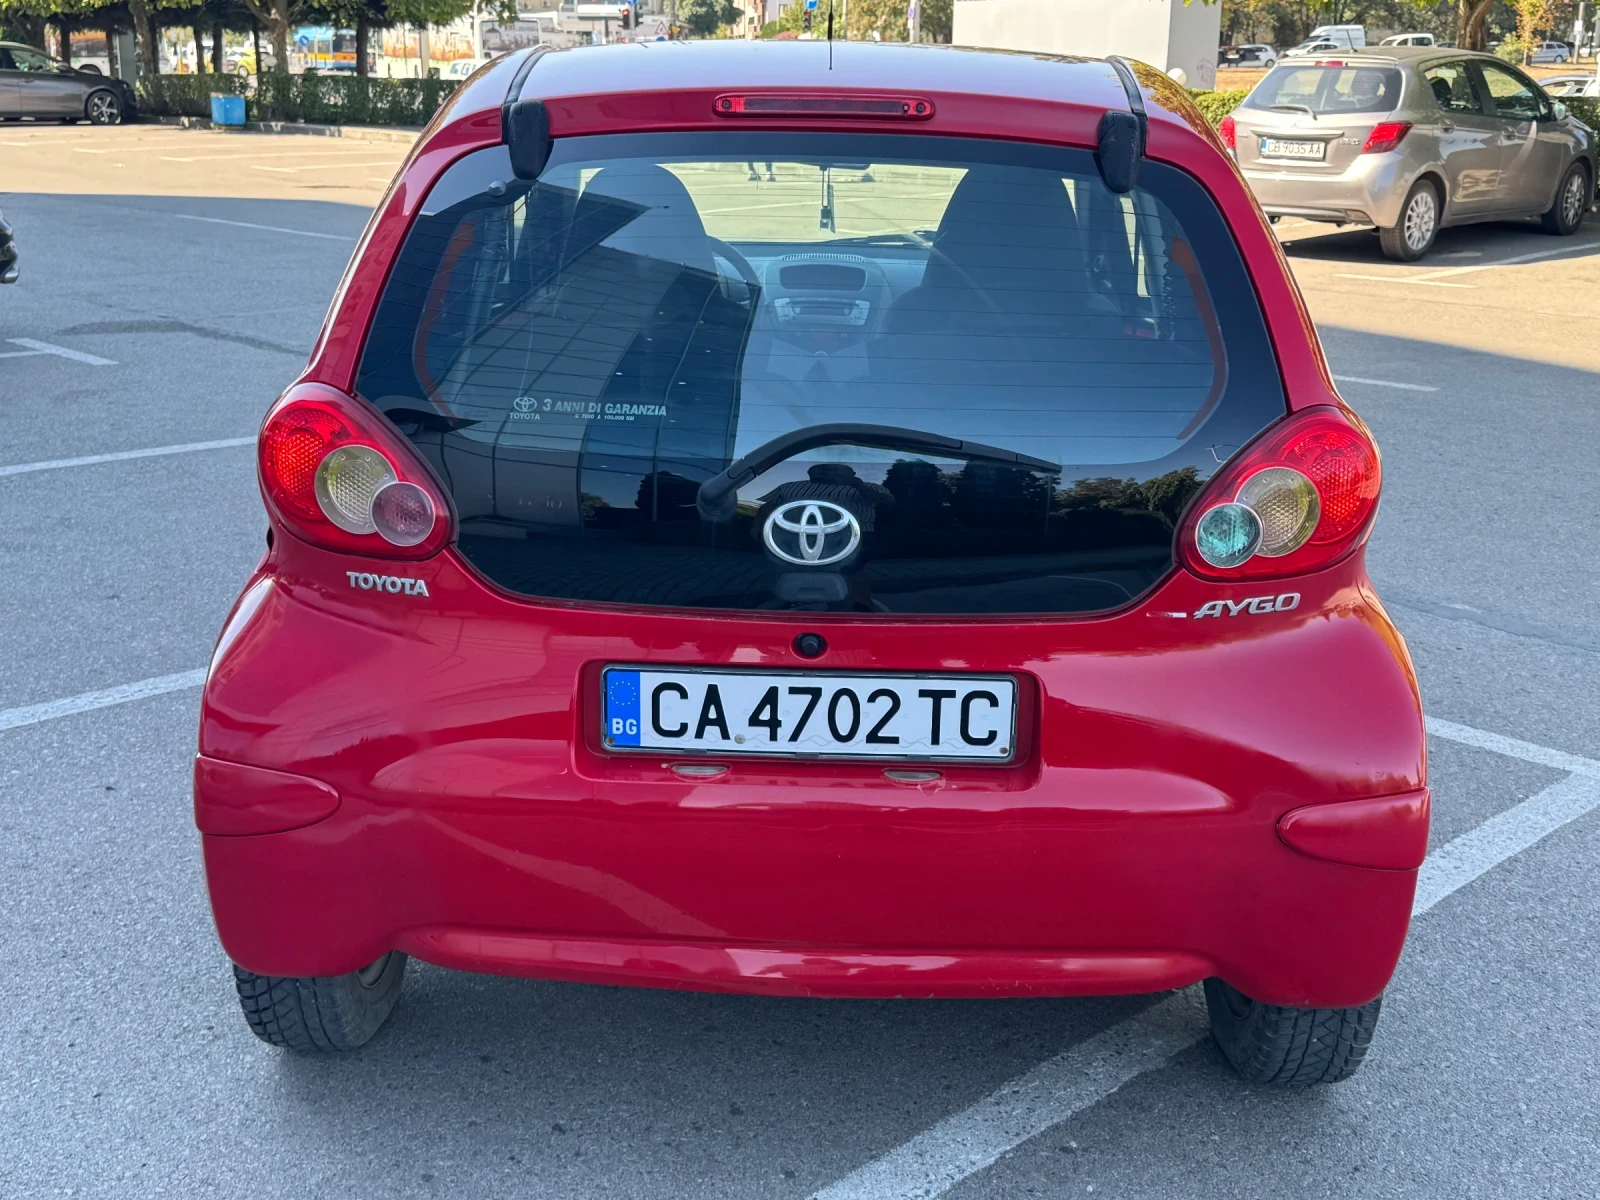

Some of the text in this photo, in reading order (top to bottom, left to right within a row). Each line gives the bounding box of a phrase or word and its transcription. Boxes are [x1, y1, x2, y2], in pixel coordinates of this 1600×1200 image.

[1267, 141, 1321, 155] CB 9035 AA
[542, 398, 667, 416] 3 ANNI DI GARANZIA
[509, 412, 541, 421] TOYOTA
[346, 571, 430, 597] TOYOTA
[1193, 592, 1301, 619] AYGO
[651, 681, 1000, 747] CA 4702 TC
[611, 717, 638, 735] BG
